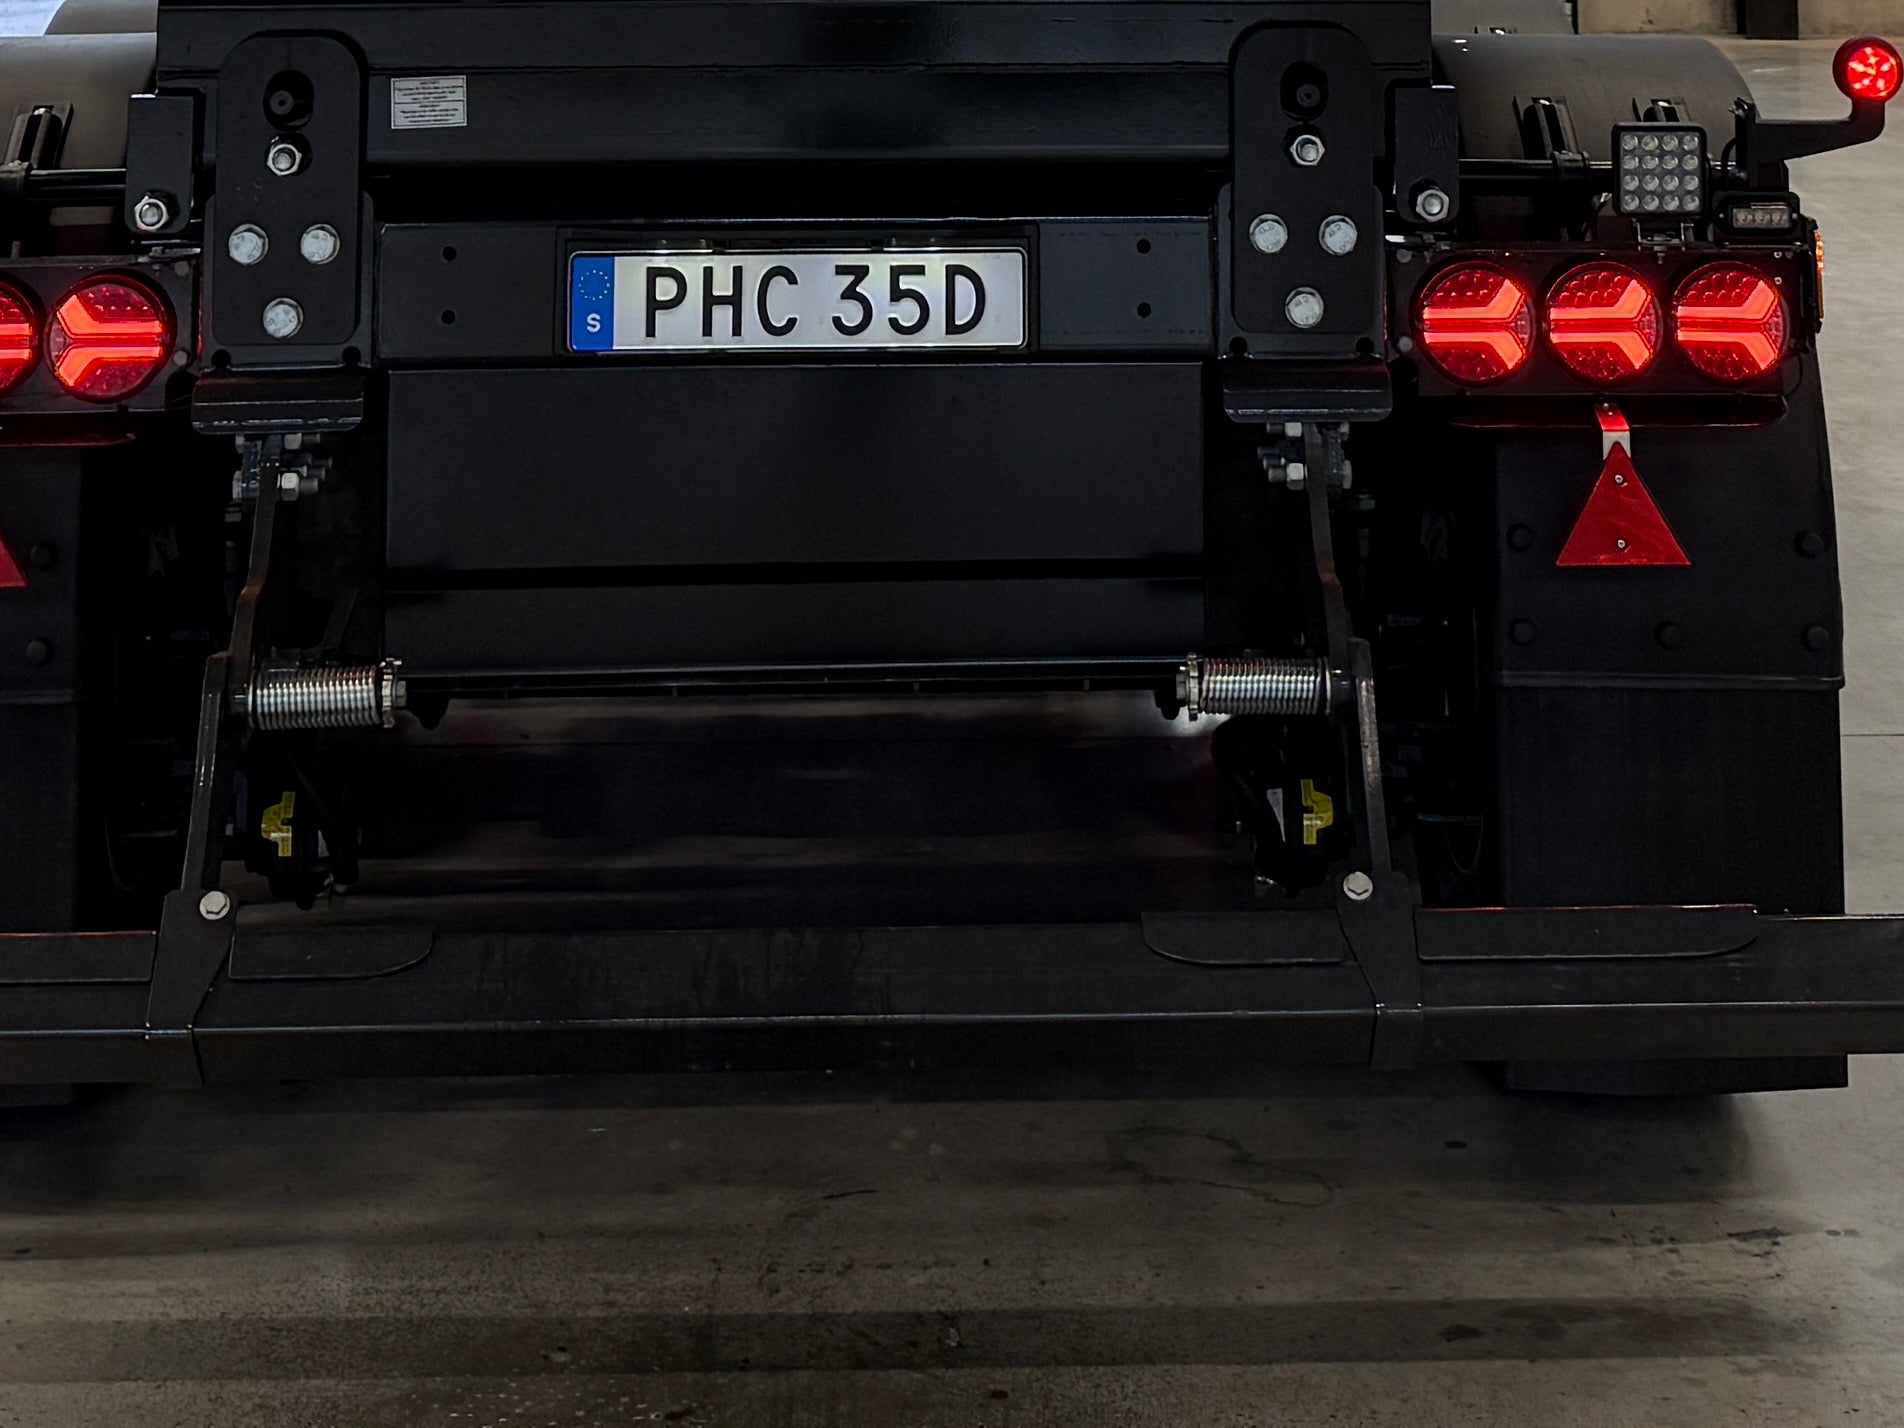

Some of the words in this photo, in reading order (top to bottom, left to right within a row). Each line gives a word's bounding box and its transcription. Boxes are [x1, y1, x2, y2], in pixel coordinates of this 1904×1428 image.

[586, 312, 601, 333] S
[645, 265, 799, 338] PHC
[831, 264, 986, 337] 35D
